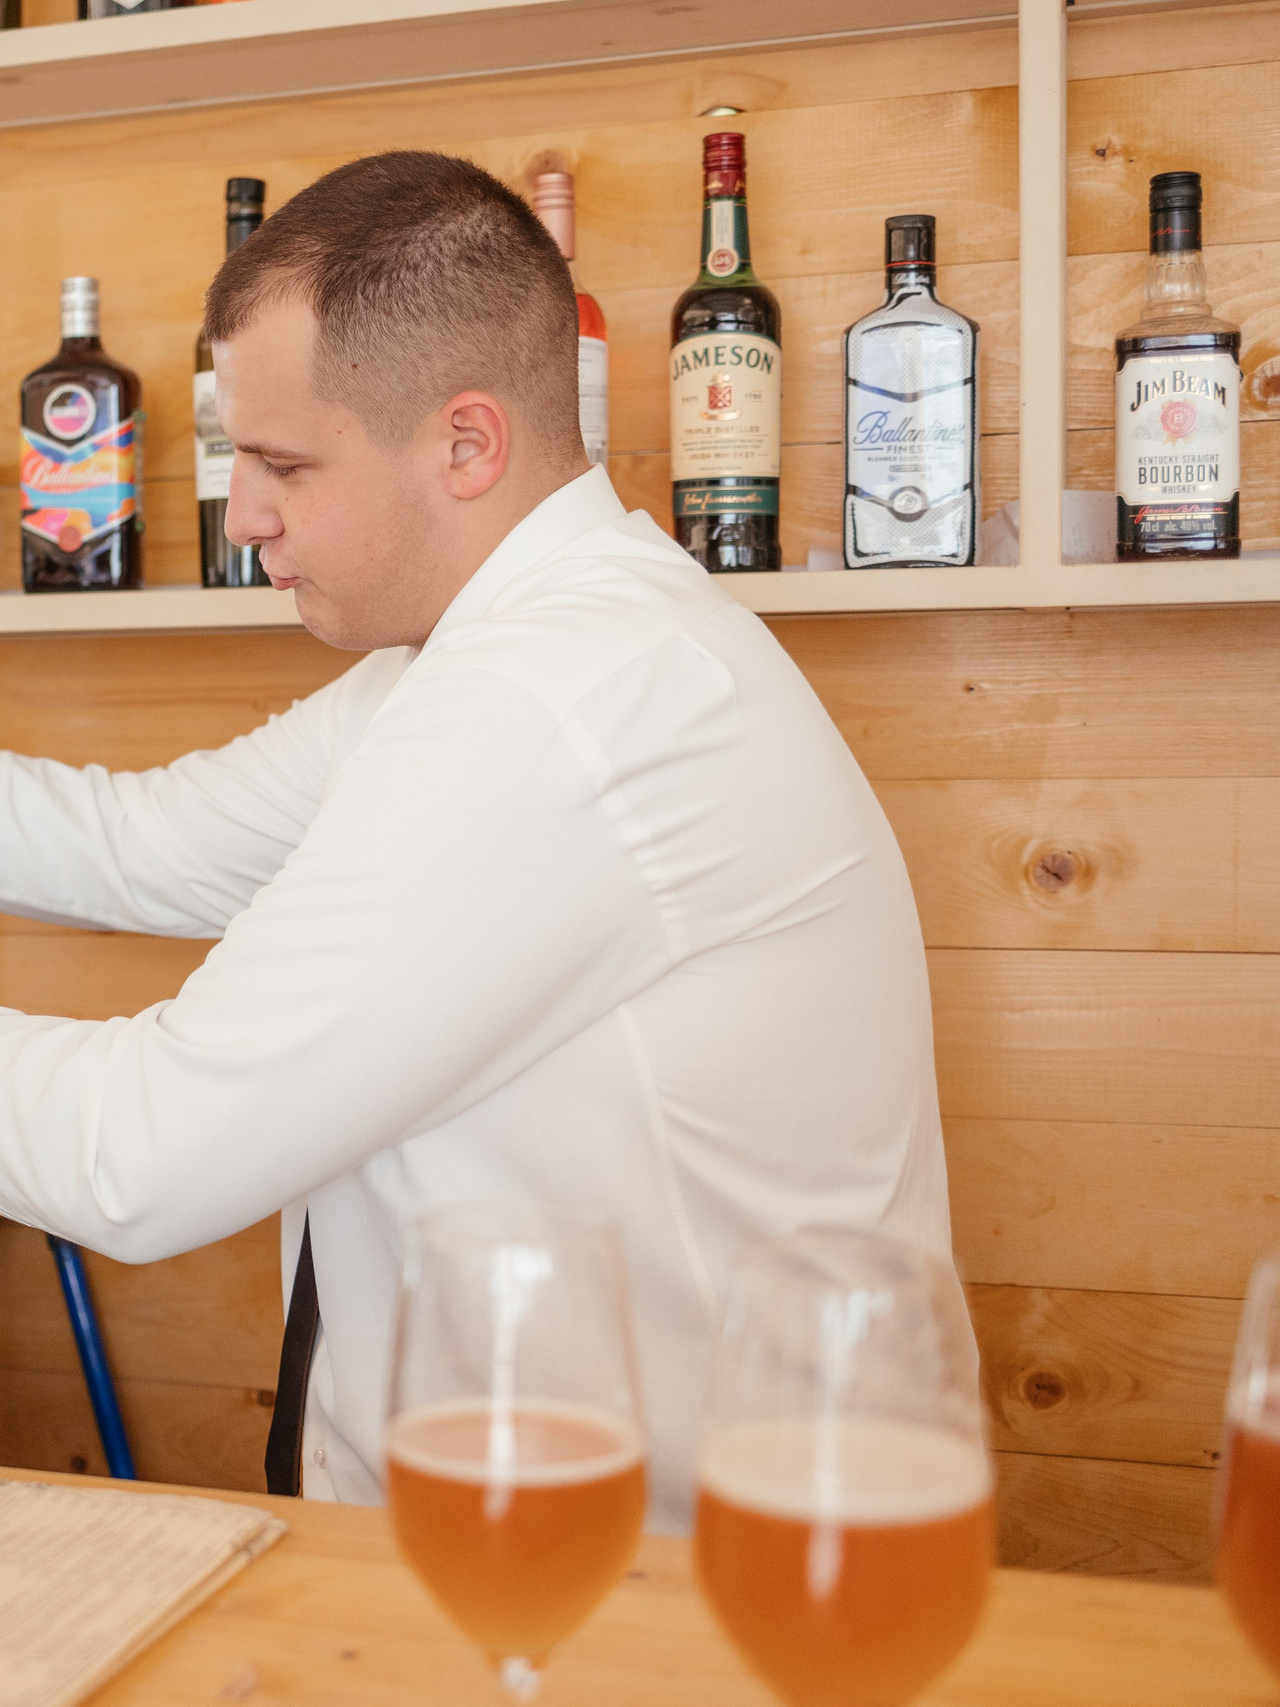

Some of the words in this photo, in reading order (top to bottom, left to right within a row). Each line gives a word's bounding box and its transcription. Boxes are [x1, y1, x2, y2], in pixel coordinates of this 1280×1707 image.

[673, 345, 775, 382] JAMESON
[1130, 378, 1167, 412] JIM
[1172, 370, 1227, 407] BEAM
[886, 444, 933, 454] FINEST
[1138, 455, 1179, 466] KENTUCKY
[1181, 453, 1220, 464] STRAIGHT
[1138, 464, 1219, 485] BOURBON
[1161, 484, 1197, 495] WHISKEY
[1140, 522, 1151, 533] 70
[1180, 519, 1200, 532] 40%
[1202, 518, 1218, 531] vol.
